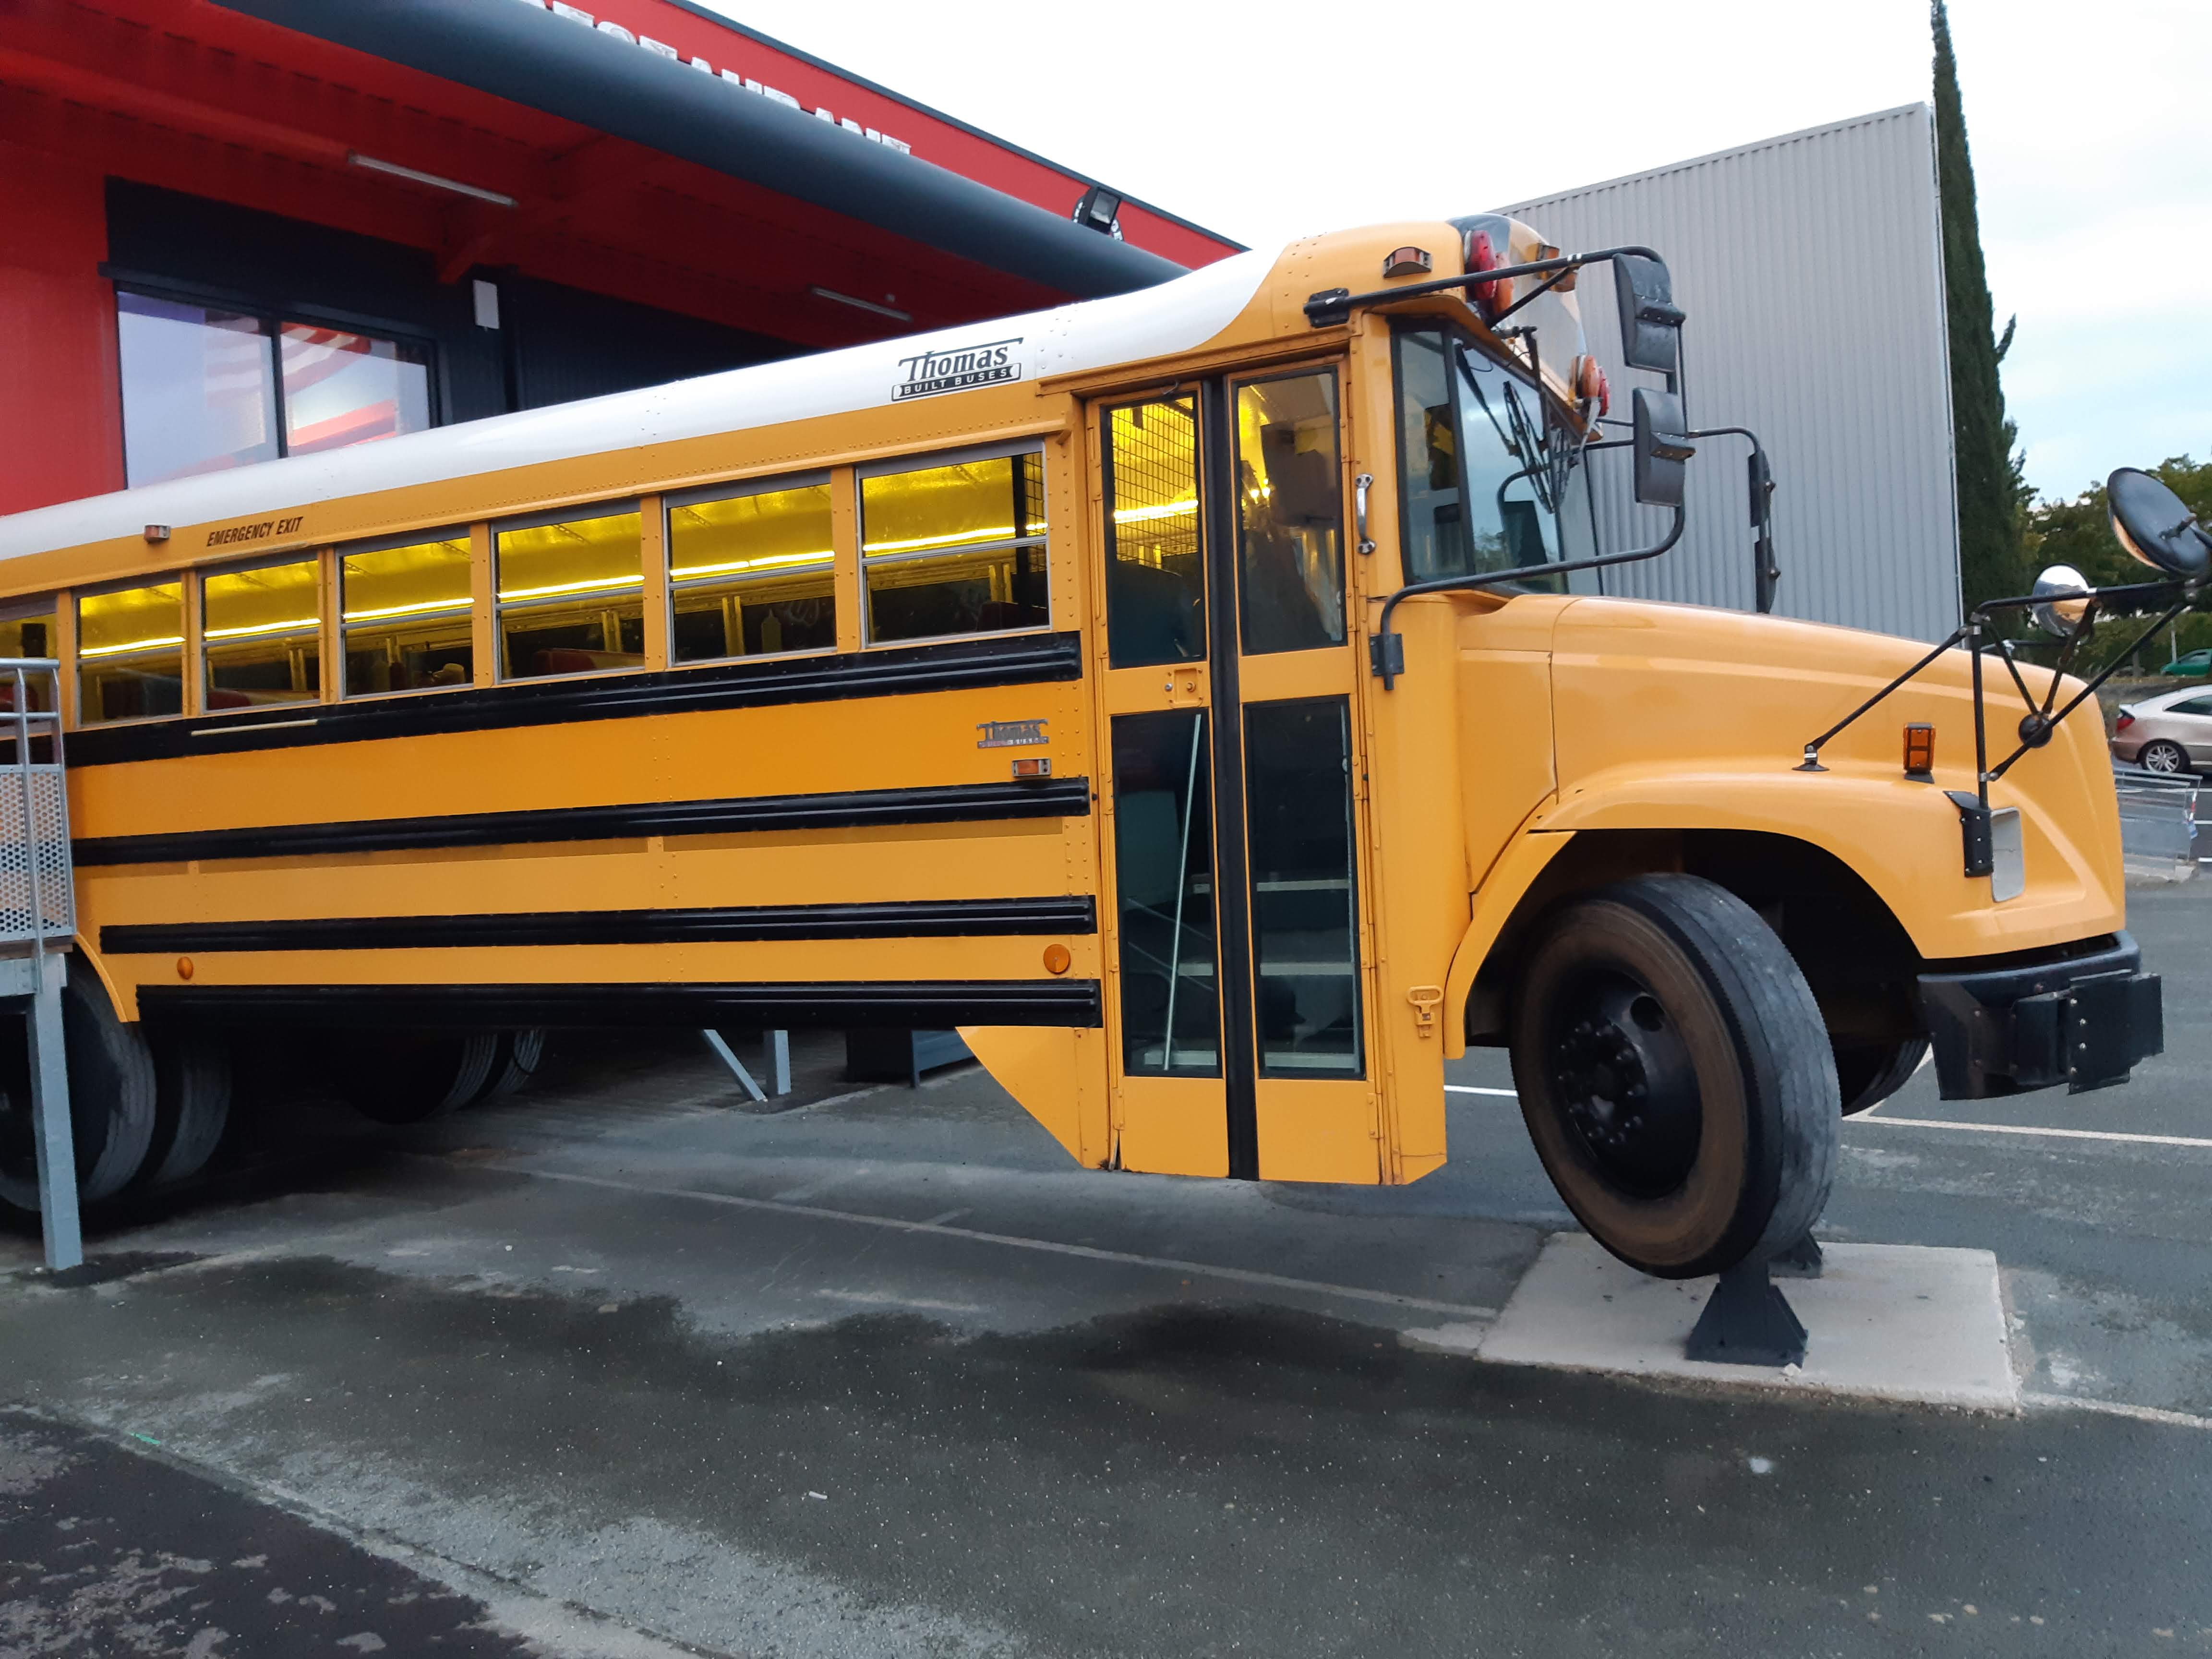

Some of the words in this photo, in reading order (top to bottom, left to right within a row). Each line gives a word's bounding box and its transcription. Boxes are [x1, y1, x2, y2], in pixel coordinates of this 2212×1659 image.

[898, 337, 1024, 382] Thomas
[904, 379, 947, 395] BUILT
[954, 368, 1007, 385] BUSES
[206, 521, 275, 547] EMERGENCY
[276, 516, 304, 535] EXIT
